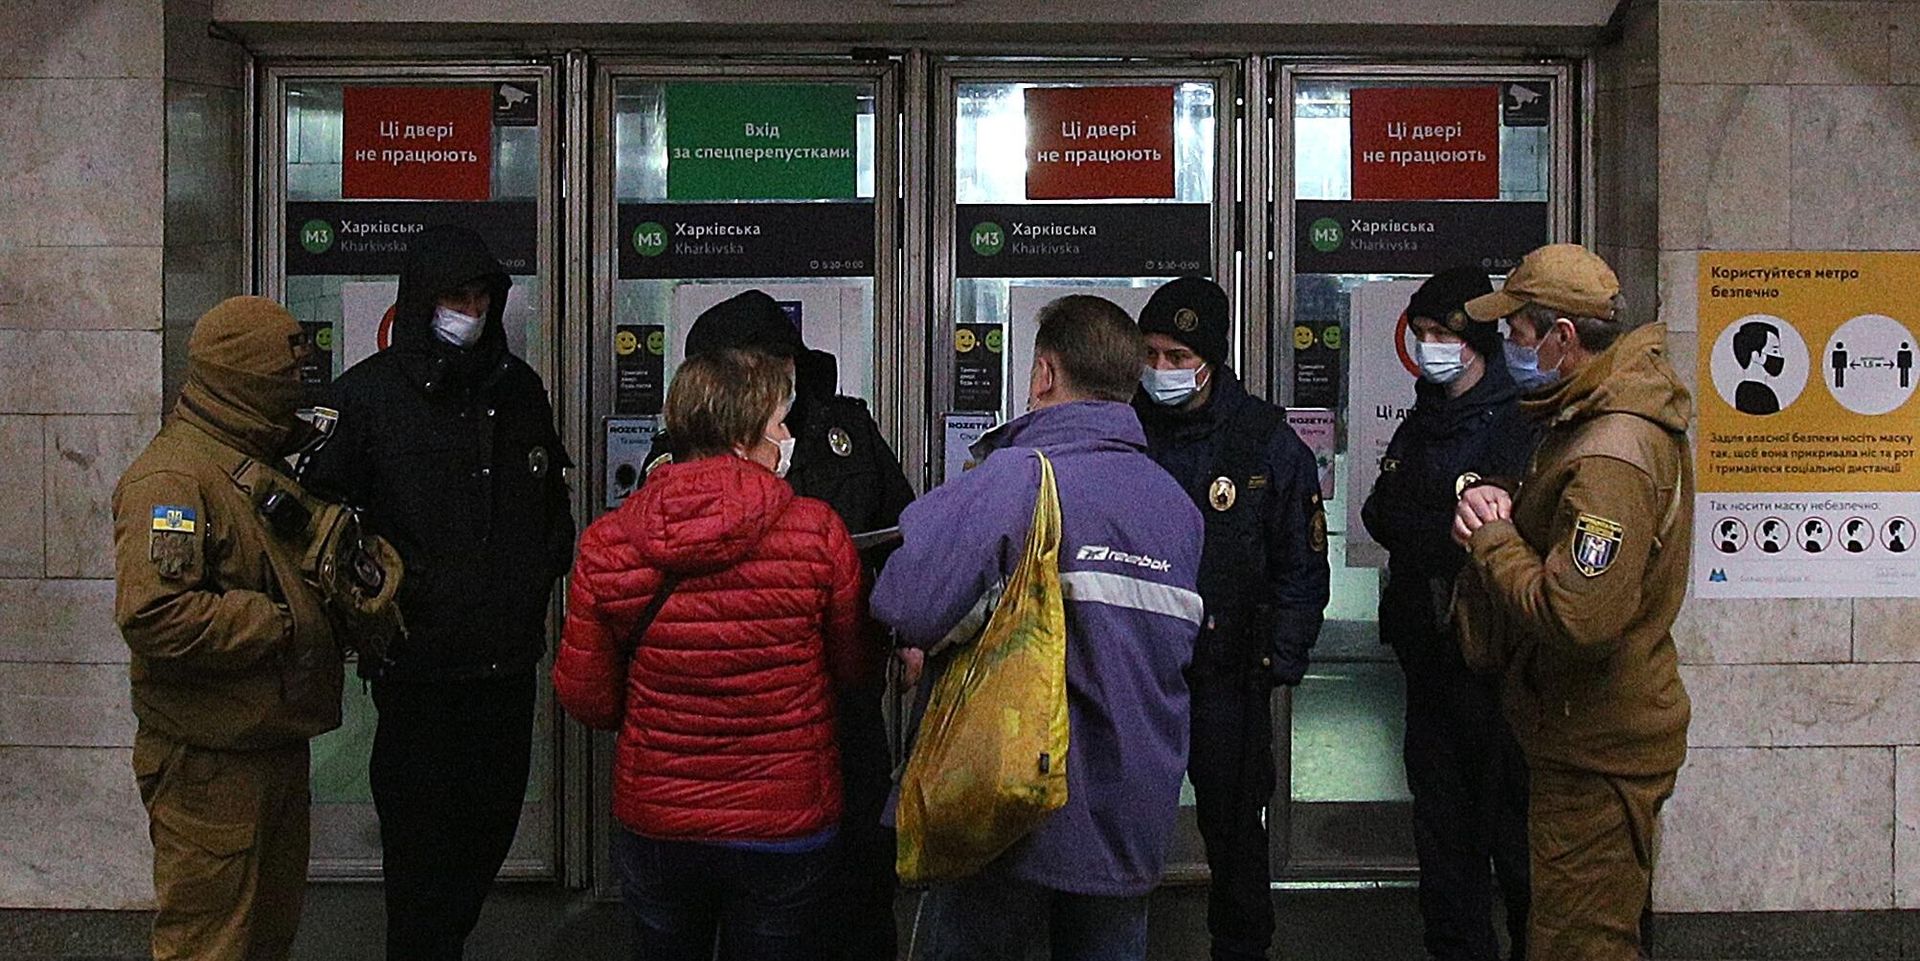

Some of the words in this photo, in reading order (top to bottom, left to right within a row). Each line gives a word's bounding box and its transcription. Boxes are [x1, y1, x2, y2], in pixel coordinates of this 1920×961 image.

[380, 121, 400, 140] Ці
[403, 122, 453, 141] двері
[745, 122, 780, 139] Вхід
[1062, 121, 1081, 140] Ці
[1086, 121, 1137, 140] двері
[1388, 122, 1407, 140] Ці
[1412, 122, 1462, 141] двері
[355, 150, 378, 161] не
[381, 150, 478, 166] працюють
[673, 148, 690, 159] за
[695, 147, 850, 162] спецперепустками
[1037, 151, 1059, 162] не
[1064, 150, 1162, 166] працюють
[1363, 151, 1385, 162] не
[1391, 150, 1487, 166] працюють
[341, 220, 424, 235] Харківська
[675, 222, 760, 238] Харківська
[1012, 222, 1097, 238] Харківська
[1351, 218, 1435, 233] Харківська
[340, 239, 408, 252] Kharkivska
[675, 242, 743, 254] Kharkivska
[1012, 242, 1080, 254] Kharkivska
[1350, 239, 1417, 251] Kharkivska
[1711, 266, 1811, 281] Користуйтеся
[1815, 269, 1859, 281] метро
[1711, 285, 1779, 298] безпечно
[1376, 405, 1392, 420] Ці
[609, 426, 657, 434] ROZETKA
[1710, 432, 1744, 444] Задля
[1746, 432, 1790, 443] власної
[1792, 431, 1840, 443] безпеки
[1841, 432, 1877, 443] носіть
[1879, 434, 1914, 445] маску
[1734, 447, 1759, 459] щоб
[1761, 450, 1788, 458] вона
[1791, 450, 1857, 460] прикривала
[1860, 448, 1877, 458] ніс
[1881, 450, 1892, 458] та
[1894, 450, 1915, 460] рот
[1716, 464, 1782, 475] тримайтеся
[1784, 463, 1845, 474] соціальної
[1847, 463, 1901, 474] дистанції
[1710, 501, 1728, 511] Так
[1731, 503, 1772, 511] носити
[1774, 503, 1808, 512] маску
